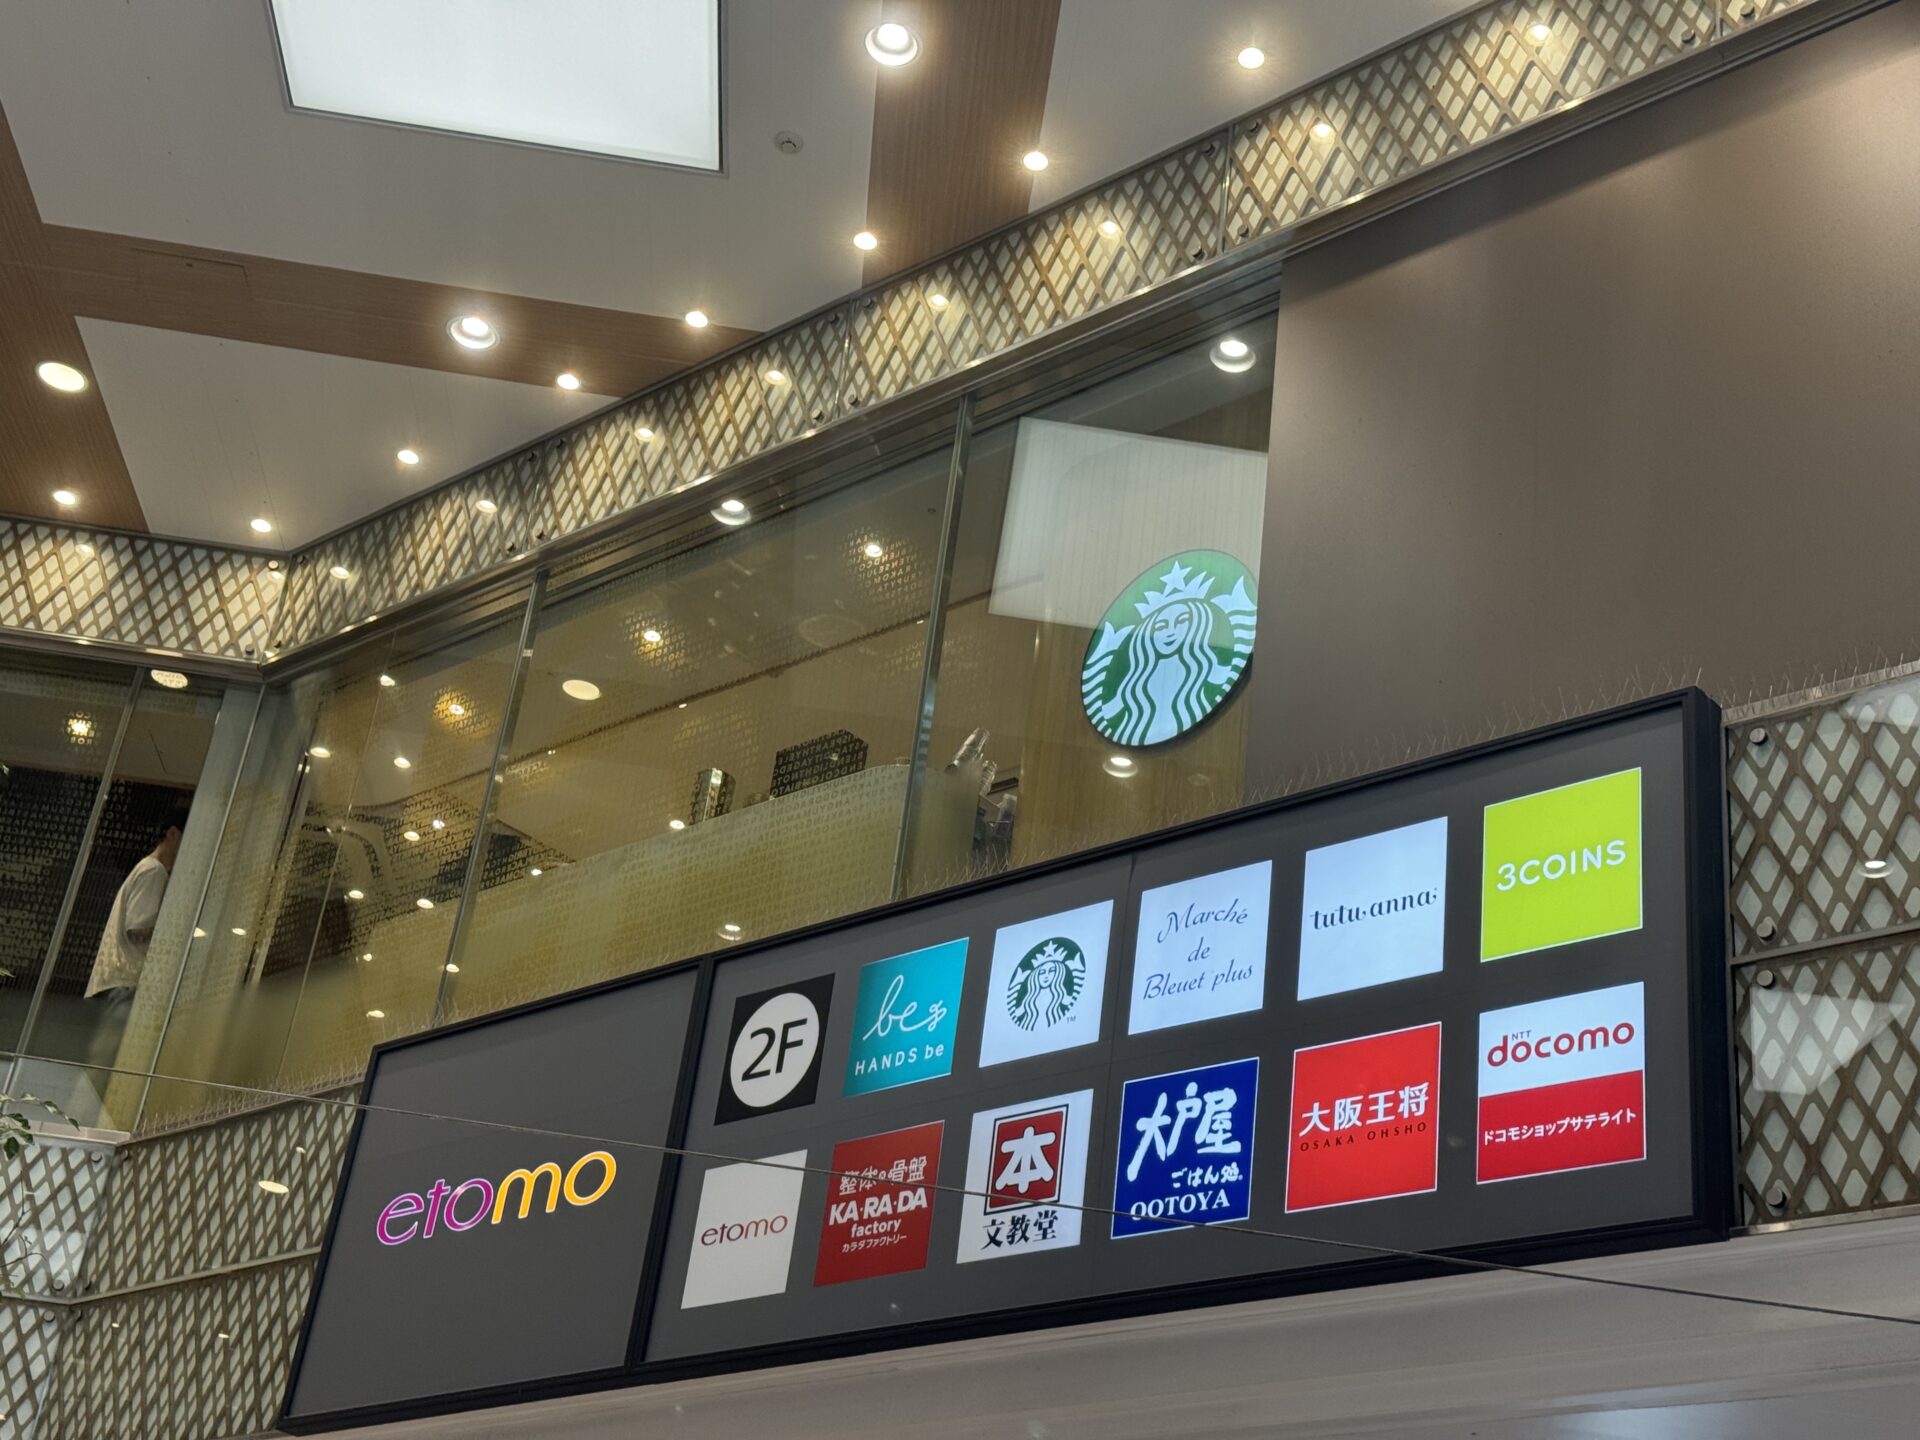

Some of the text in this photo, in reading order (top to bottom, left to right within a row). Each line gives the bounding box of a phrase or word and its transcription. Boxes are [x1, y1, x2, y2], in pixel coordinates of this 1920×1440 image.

[1496, 839, 1627, 892] 3COINS
[1156, 897, 1249, 944] Marché
[1187, 936, 1211, 963] de
[1143, 958, 1253, 1000] Bleuet plus
[741, 1017, 809, 1082] 2F
[1486, 1021, 1635, 1067] docomo
[1511, 1029, 1533, 1042] NTT
[854, 1043, 945, 1076] HANDS be
[1298, 1081, 1430, 1138] 大阪王将
[1483, 1107, 1637, 1146] ドコモショップサテライト
[1126, 1081, 1242, 1182] 大戸屋
[1300, 1121, 1427, 1152] OSAKA OHSHO
[994, 1125, 1057, 1194] 本
[375, 1150, 617, 1246] etomo
[1130, 1188, 1230, 1221] OOTOYA
[700, 1214, 789, 1246] etomo
[841, 1234, 907, 1254] カラダファクトリー
[850, 1218, 902, 1238] factory
[980, 1209, 1059, 1250] 文教堂
